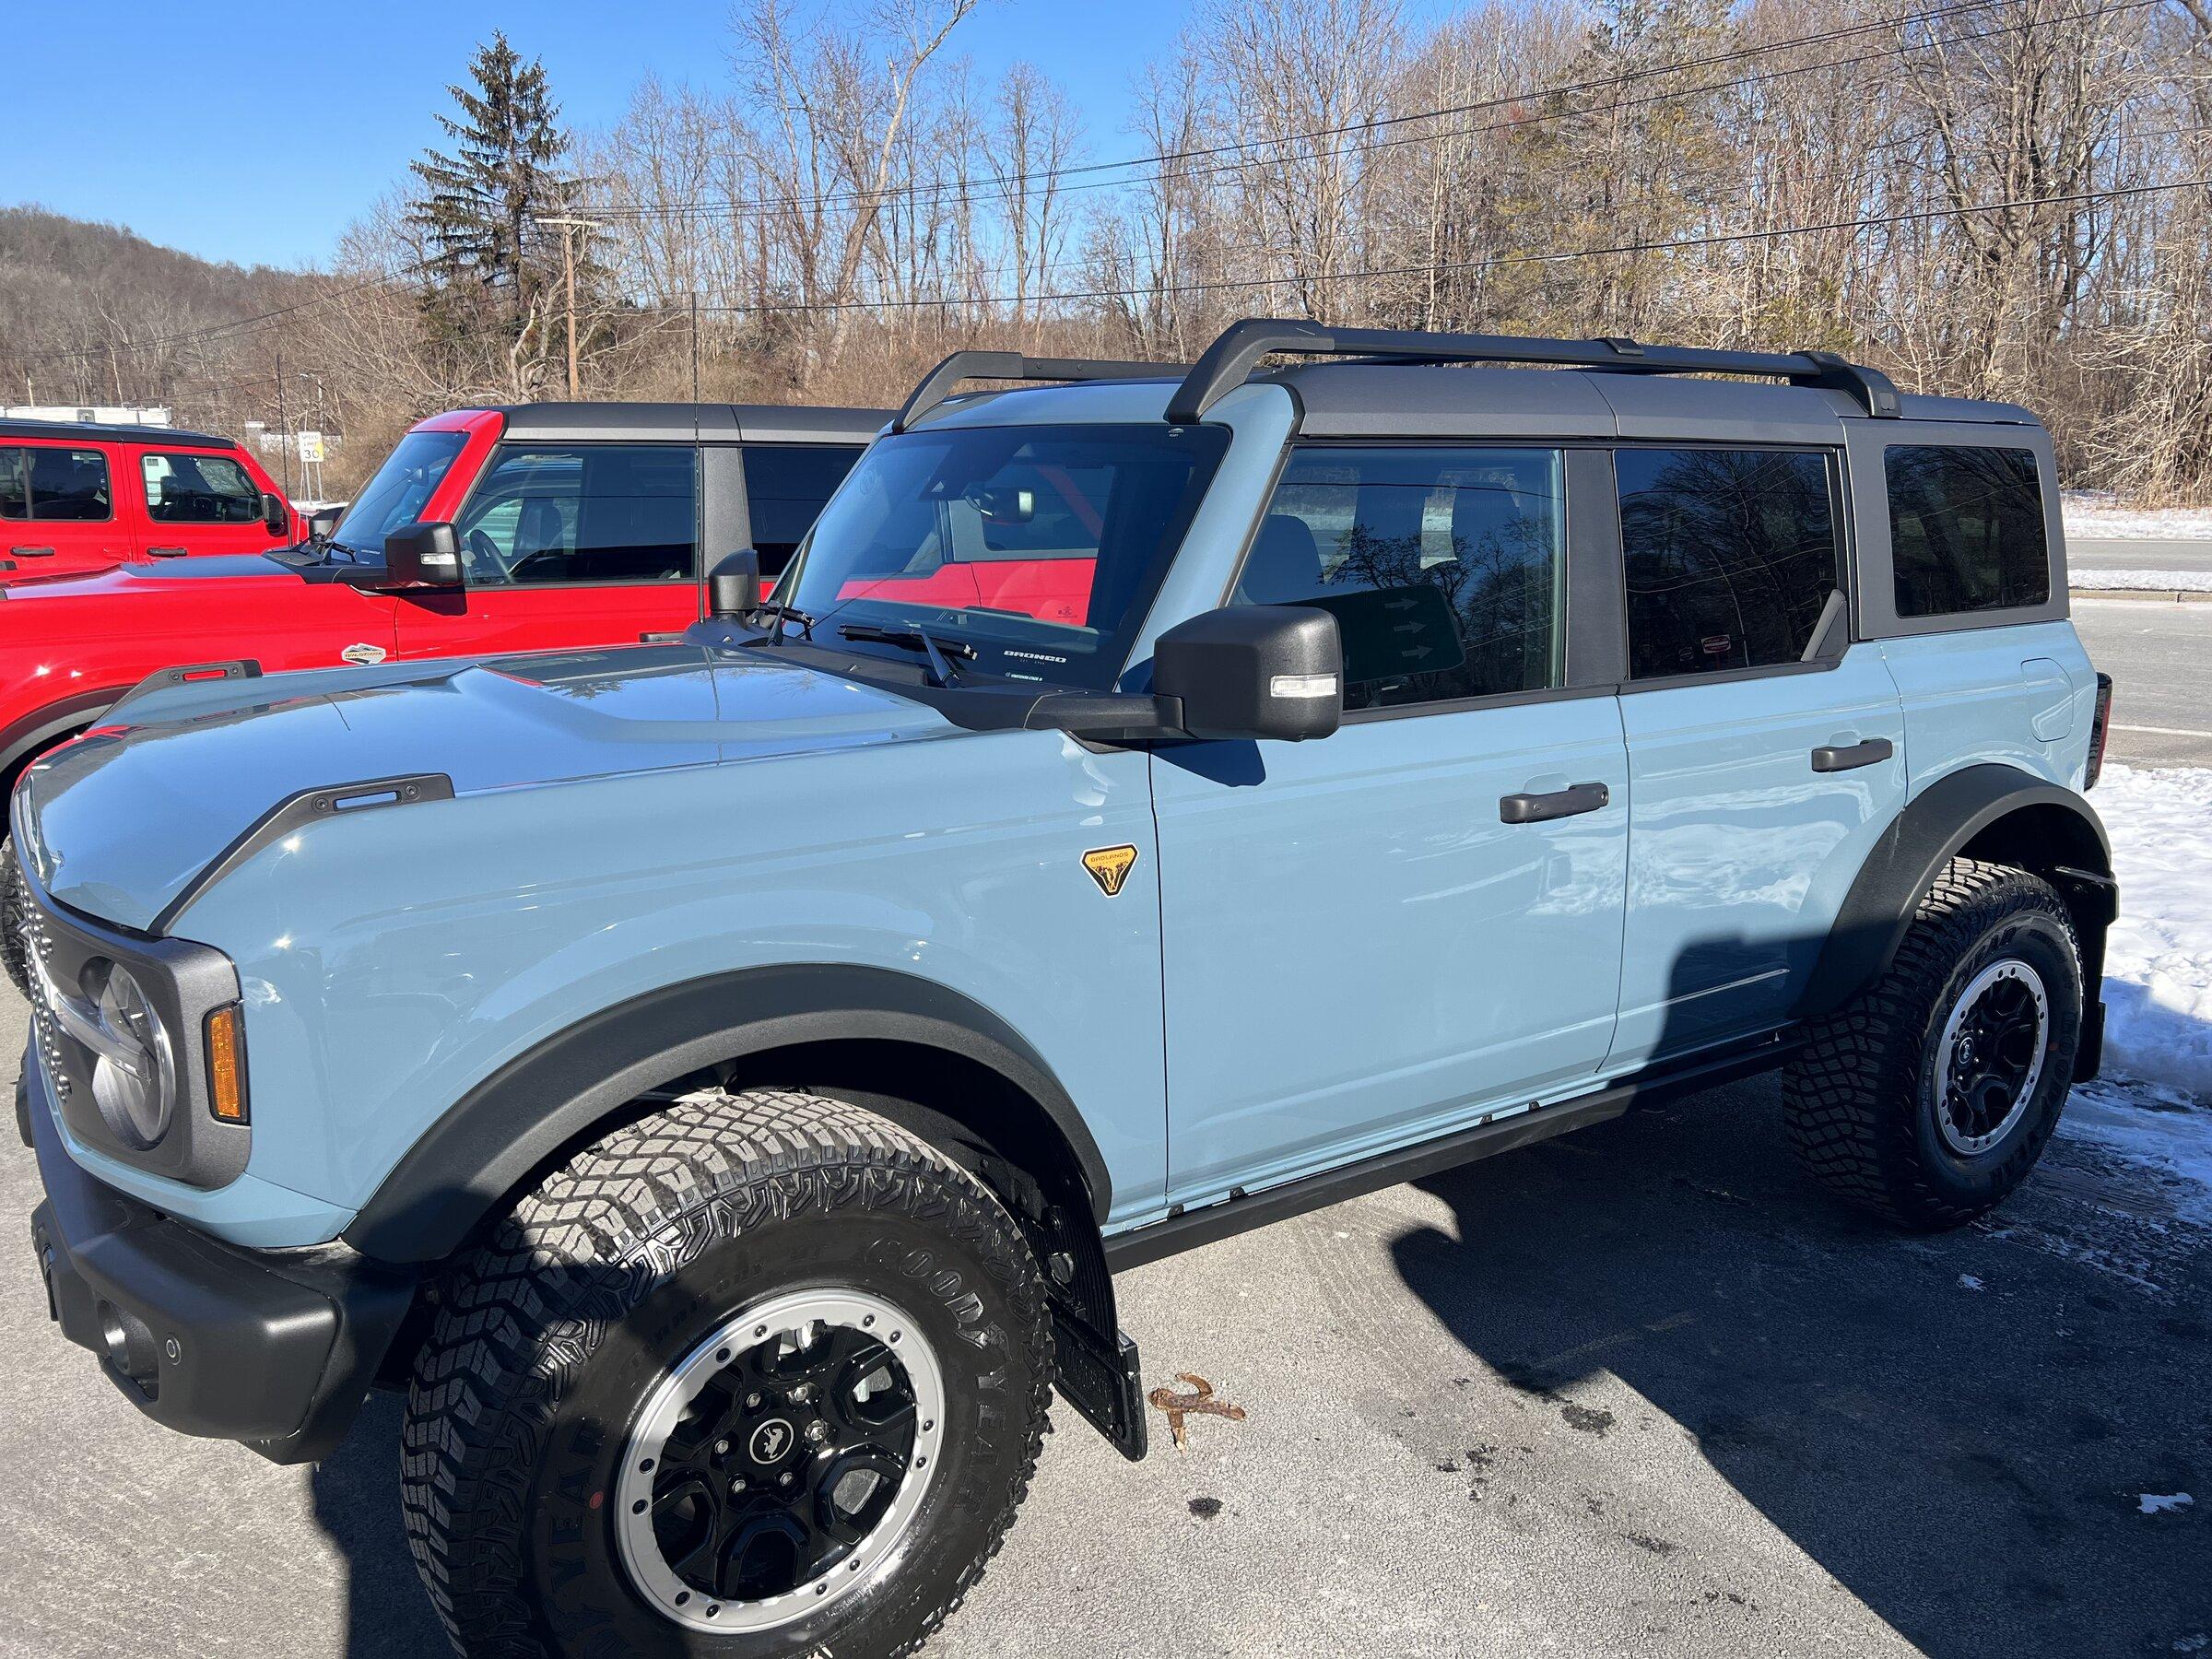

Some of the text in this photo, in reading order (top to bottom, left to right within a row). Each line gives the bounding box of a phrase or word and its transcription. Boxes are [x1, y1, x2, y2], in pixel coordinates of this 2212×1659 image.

[304, 450, 320, 459] 30
[1004, 650, 1067, 664] BRONCO
[1090, 852, 1129, 863] BADLANDS
[865, 1235, 1011, 1517] GOODYEAR
